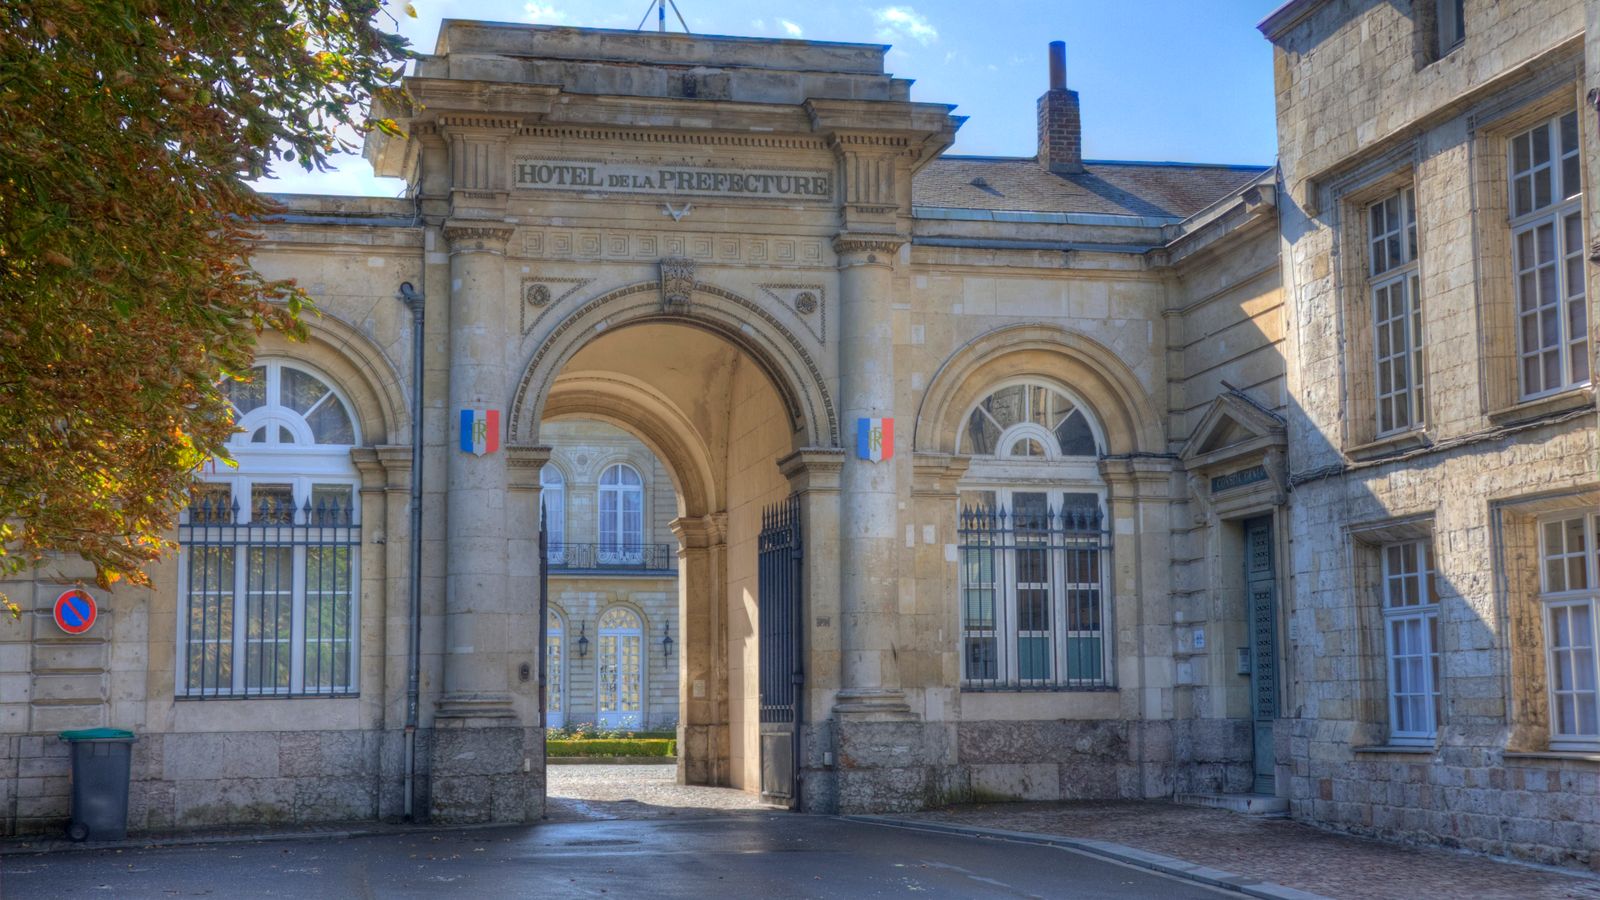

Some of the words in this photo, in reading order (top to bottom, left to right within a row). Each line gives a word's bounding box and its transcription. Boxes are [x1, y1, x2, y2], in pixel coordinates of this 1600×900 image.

[518, 164, 604, 187] HOTEL
[608, 174, 630, 187] DE
[632, 175, 656, 189] LA
[658, 170, 828, 195] PREFECTURE
